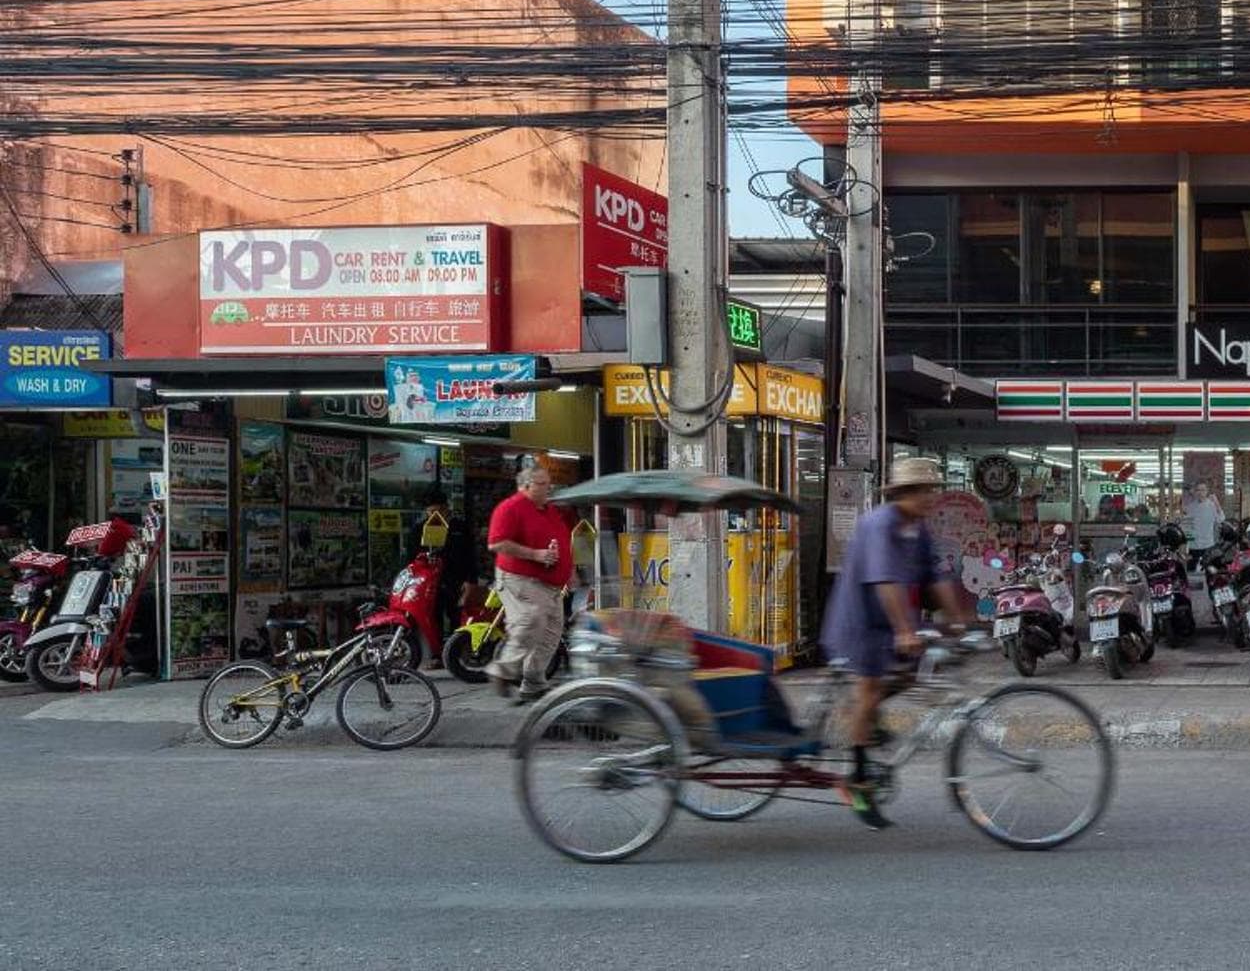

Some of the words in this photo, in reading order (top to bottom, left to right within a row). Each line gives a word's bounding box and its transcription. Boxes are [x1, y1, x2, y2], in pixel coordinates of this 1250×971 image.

[595, 184, 645, 232] KPD
[212, 239, 333, 291] KPD
[334, 252, 363, 267] CAR
[371, 251, 407, 266] RENT
[413, 251, 425, 266] &
[431, 250, 484, 266] TRAVEL
[339, 270, 366, 284] OPEN
[404, 268, 421, 282] AM
[461, 267, 478, 281] PM
[291, 327, 377, 345] LAUNDRY
[389, 326, 460, 344] SERVICE
[8, 345, 100, 366] SERVICE
[17, 378, 48, 393] WASH
[52, 379, 60, 393] &
[64, 378, 87, 393] DRY
